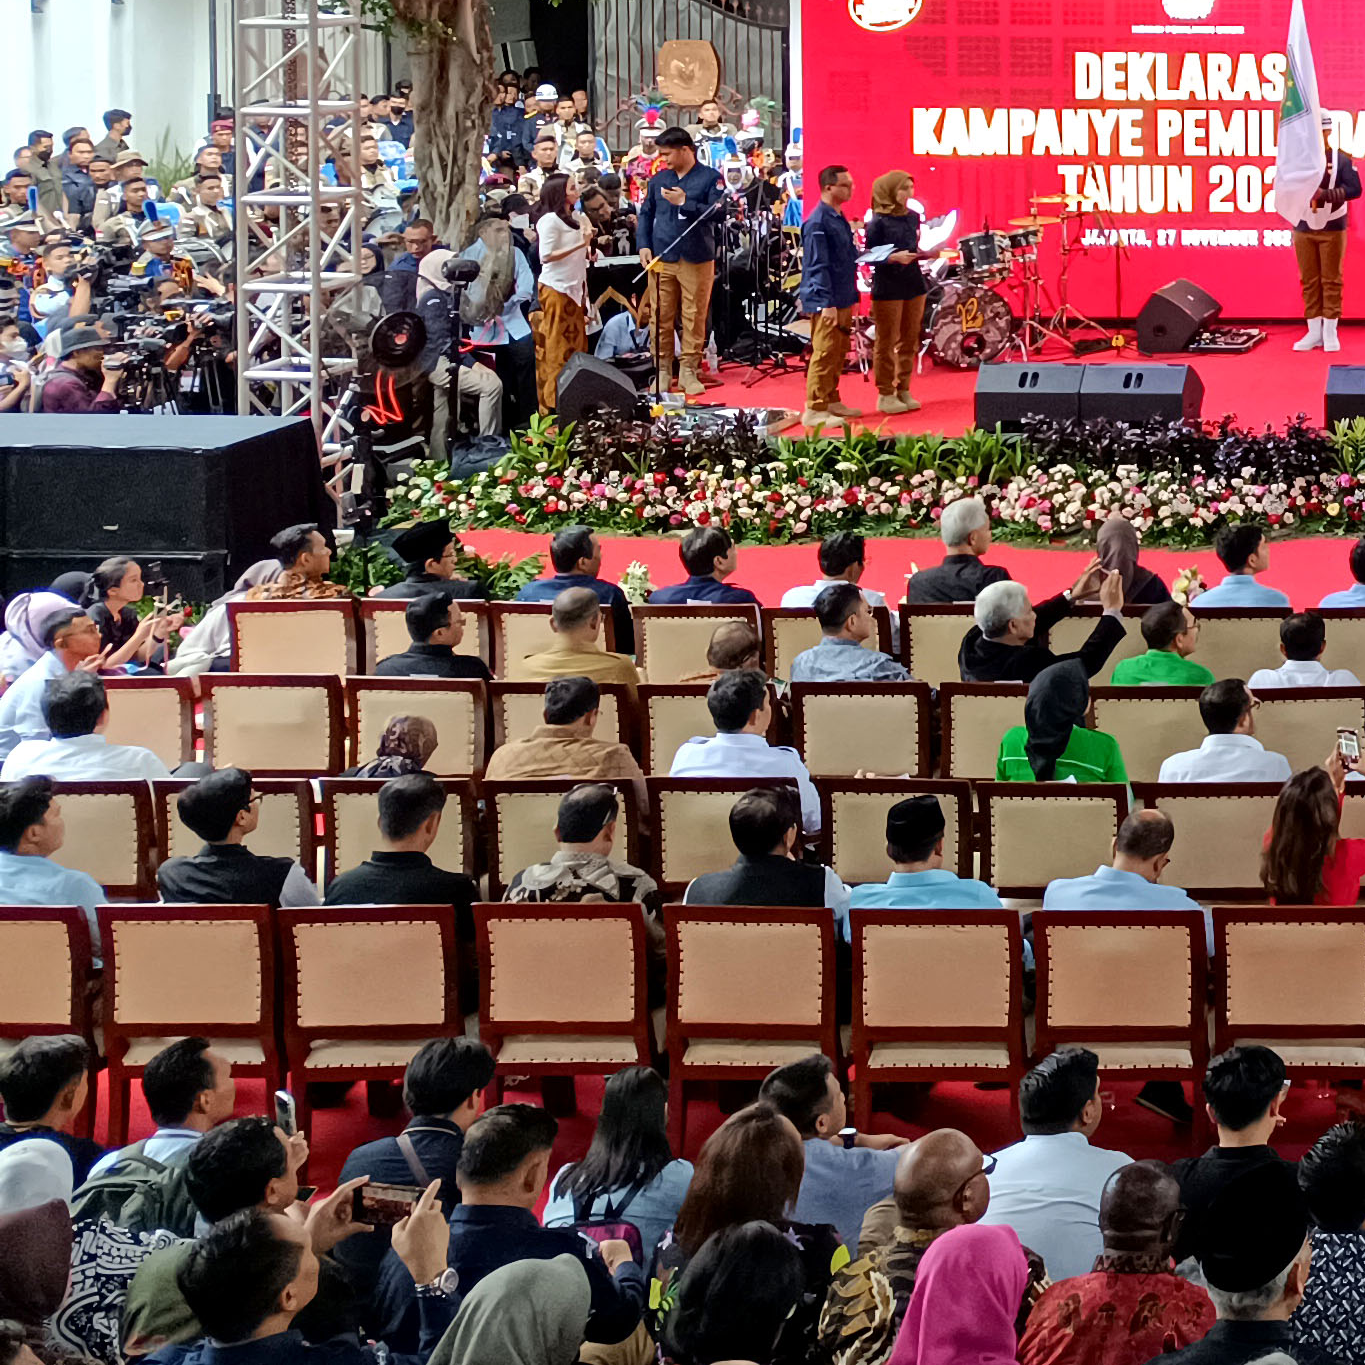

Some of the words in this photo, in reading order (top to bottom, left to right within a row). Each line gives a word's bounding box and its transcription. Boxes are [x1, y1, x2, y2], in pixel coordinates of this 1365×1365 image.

[1075, 52, 1288, 101] DEKLARAS
[912, 107, 1144, 156] KAMPANYE
[1157, 109, 1278, 157] PEMIL
[1057, 164, 1193, 213] TAHUN
